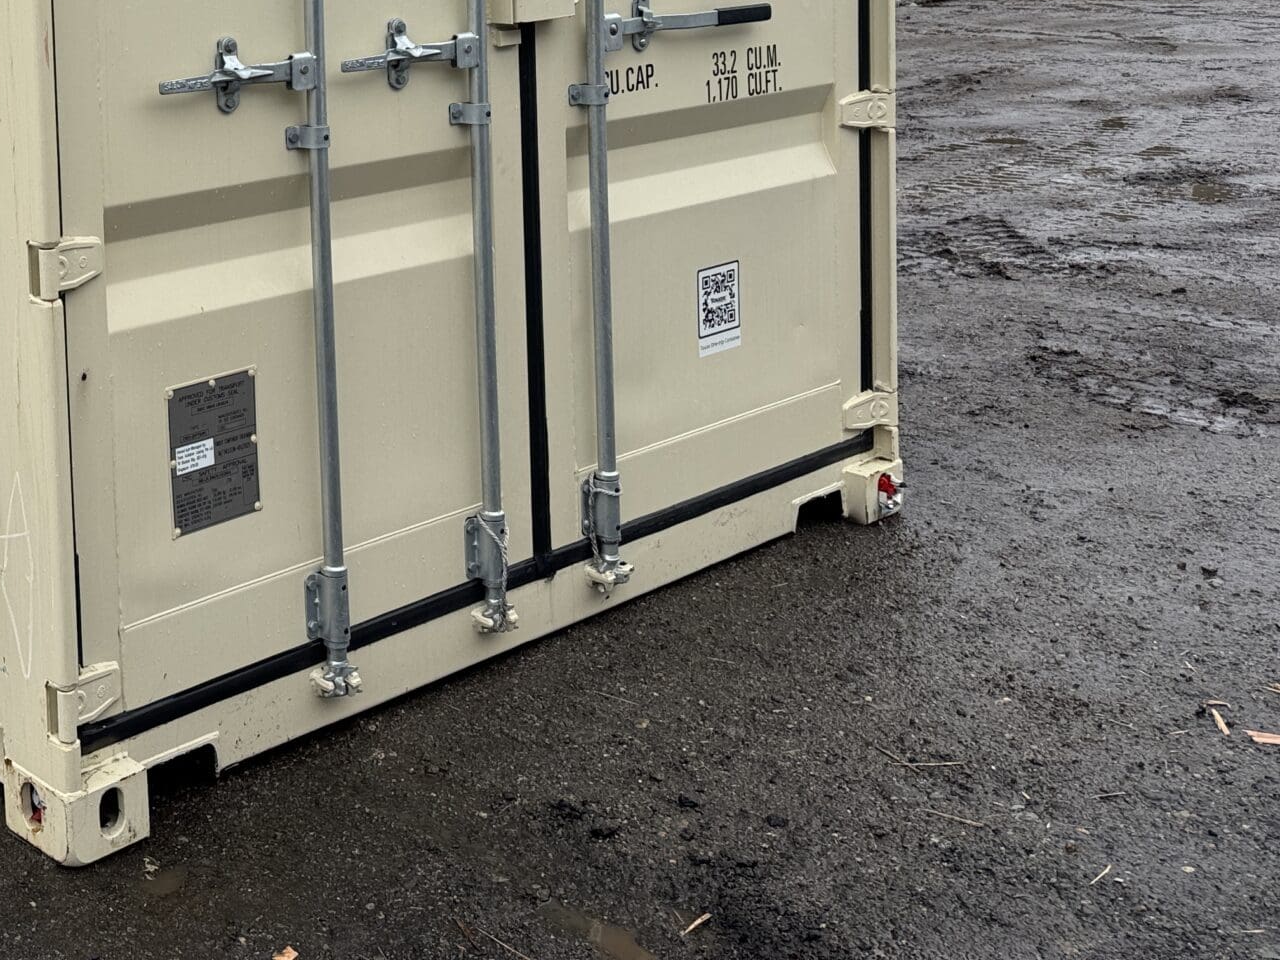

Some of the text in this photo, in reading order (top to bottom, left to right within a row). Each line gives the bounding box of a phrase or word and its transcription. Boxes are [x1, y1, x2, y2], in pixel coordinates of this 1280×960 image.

[712, 50, 737, 77] 33.2
[747, 44, 781, 71] CU.M.
[706, 69, 782, 103] 1,170 CU.FT.
